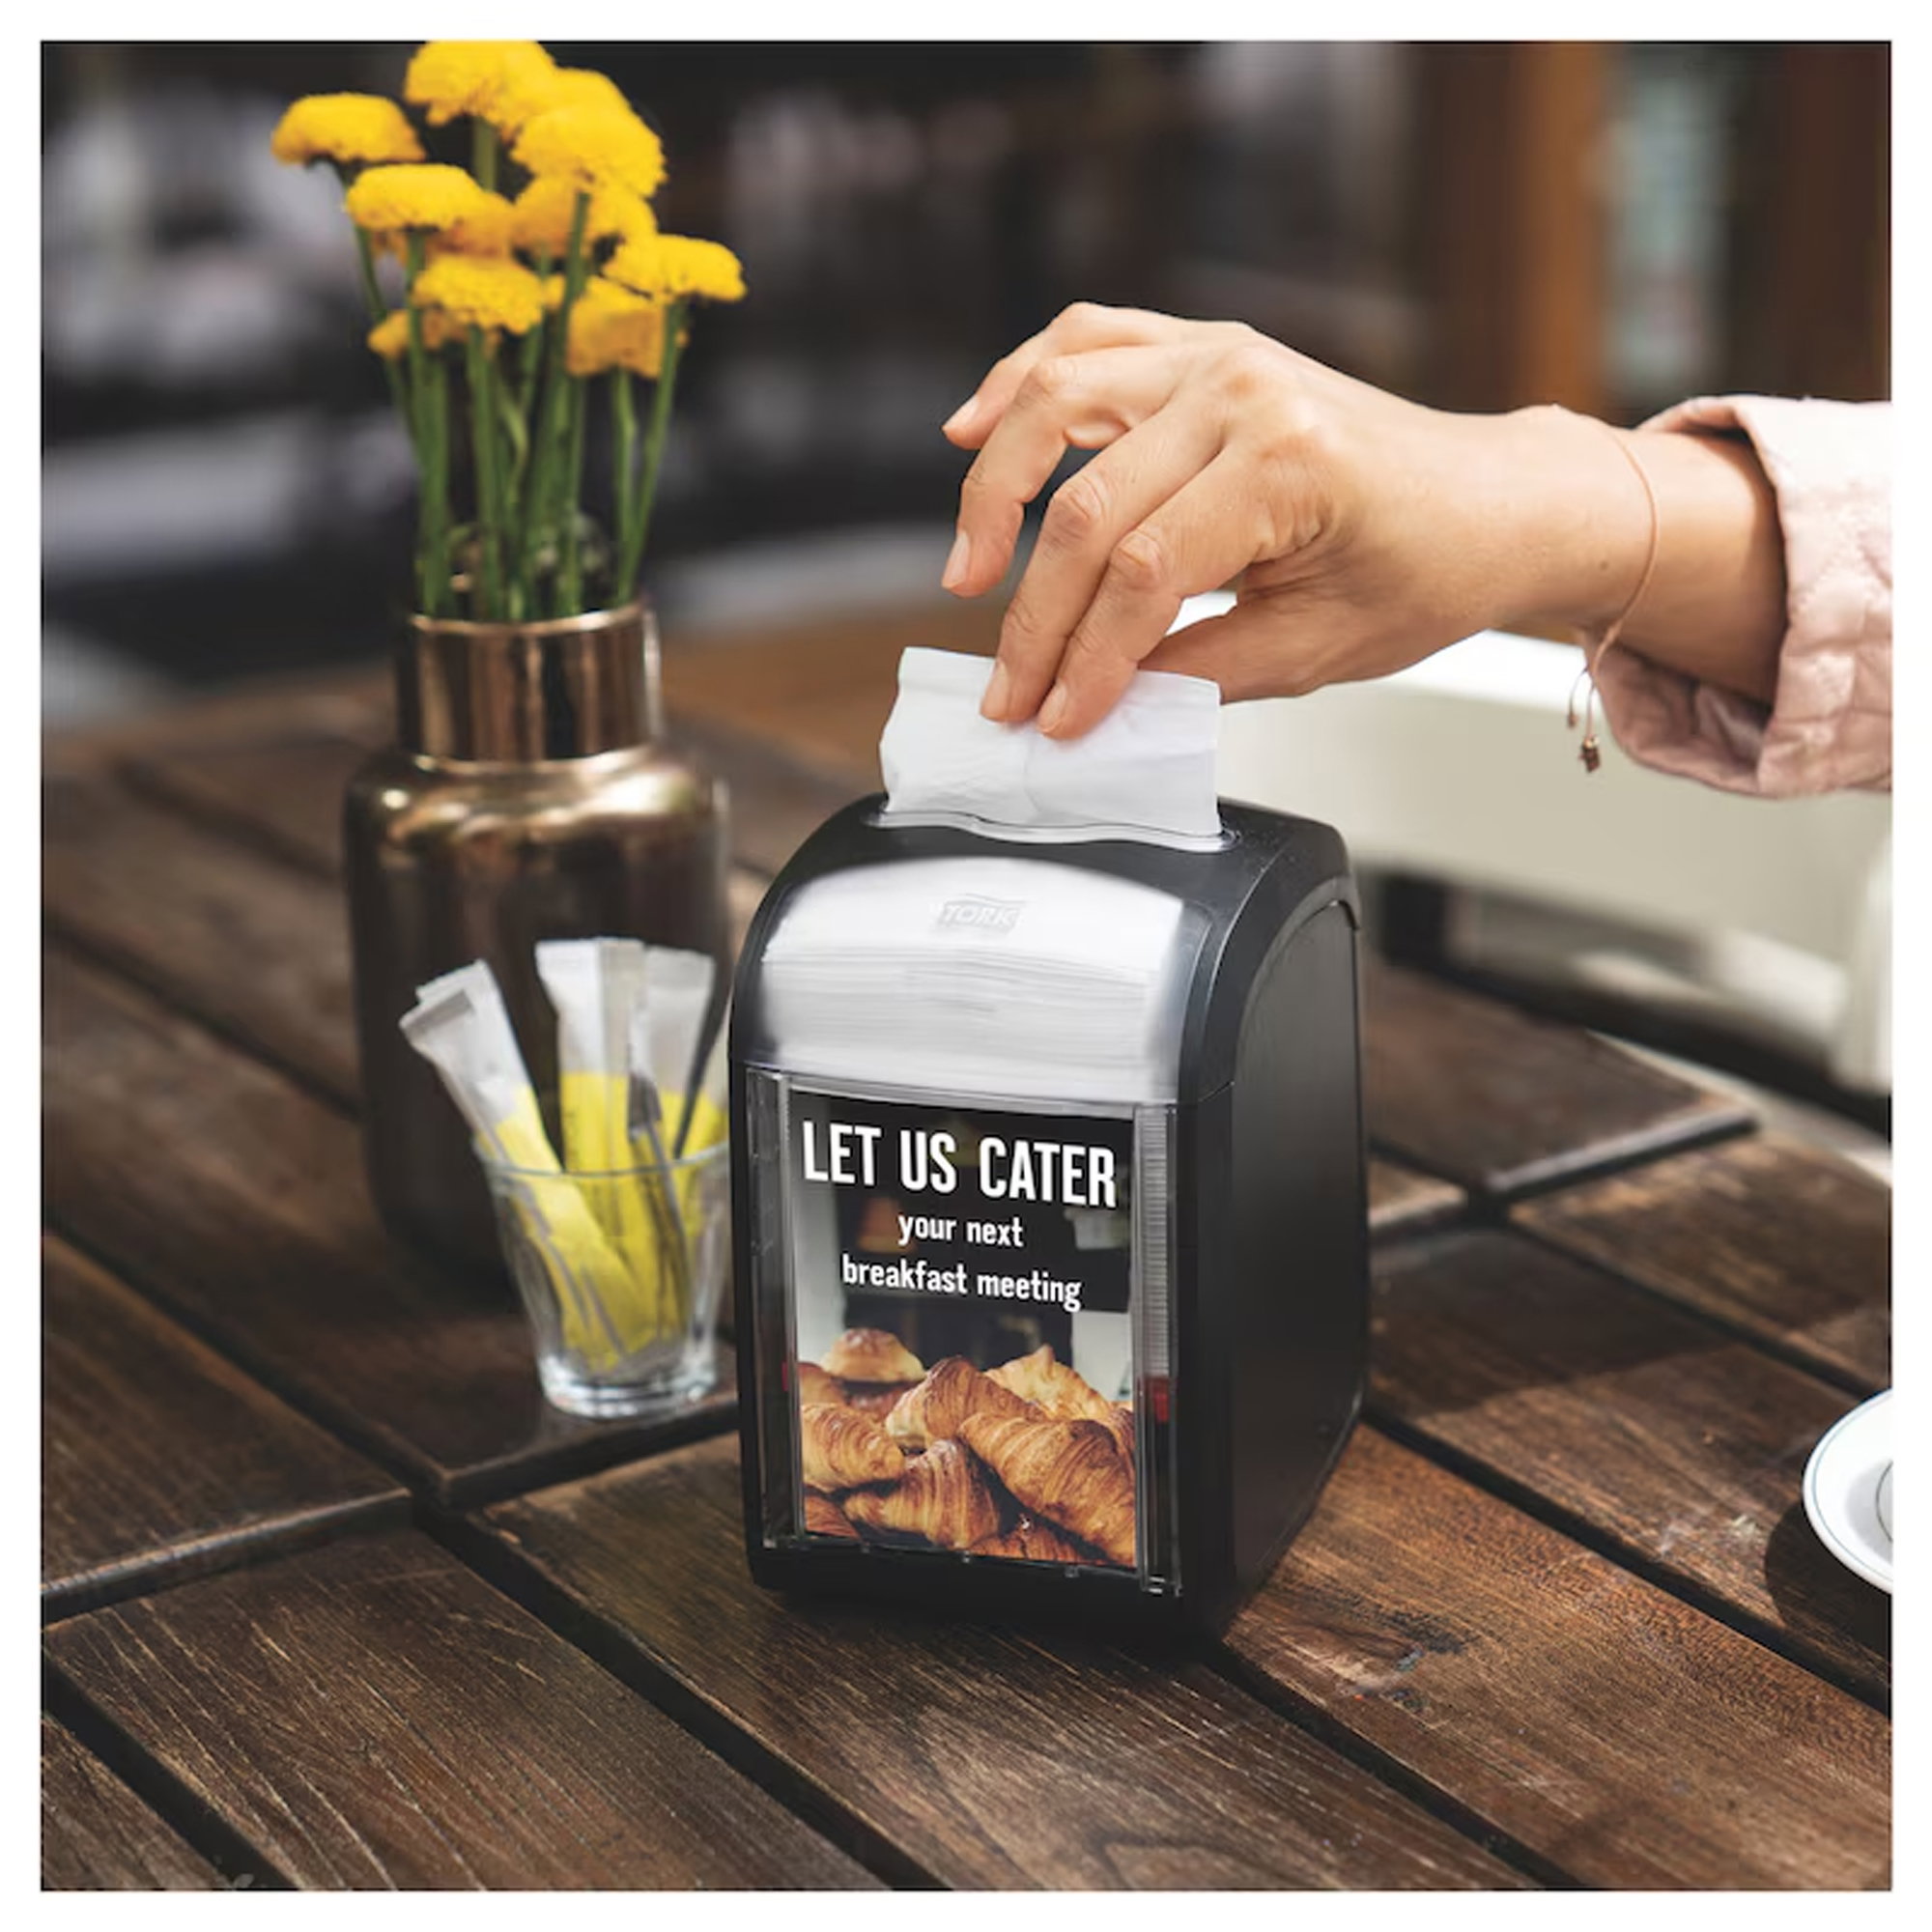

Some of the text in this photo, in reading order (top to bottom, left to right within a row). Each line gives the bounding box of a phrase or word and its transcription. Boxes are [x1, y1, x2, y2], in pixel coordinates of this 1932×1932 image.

[942, 905, 1021, 928] TORK
[802, 1121, 1117, 1208] LET US CATER
[897, 1214, 1024, 1247] your next
[841, 1253, 1082, 1313] breakfast meeting
